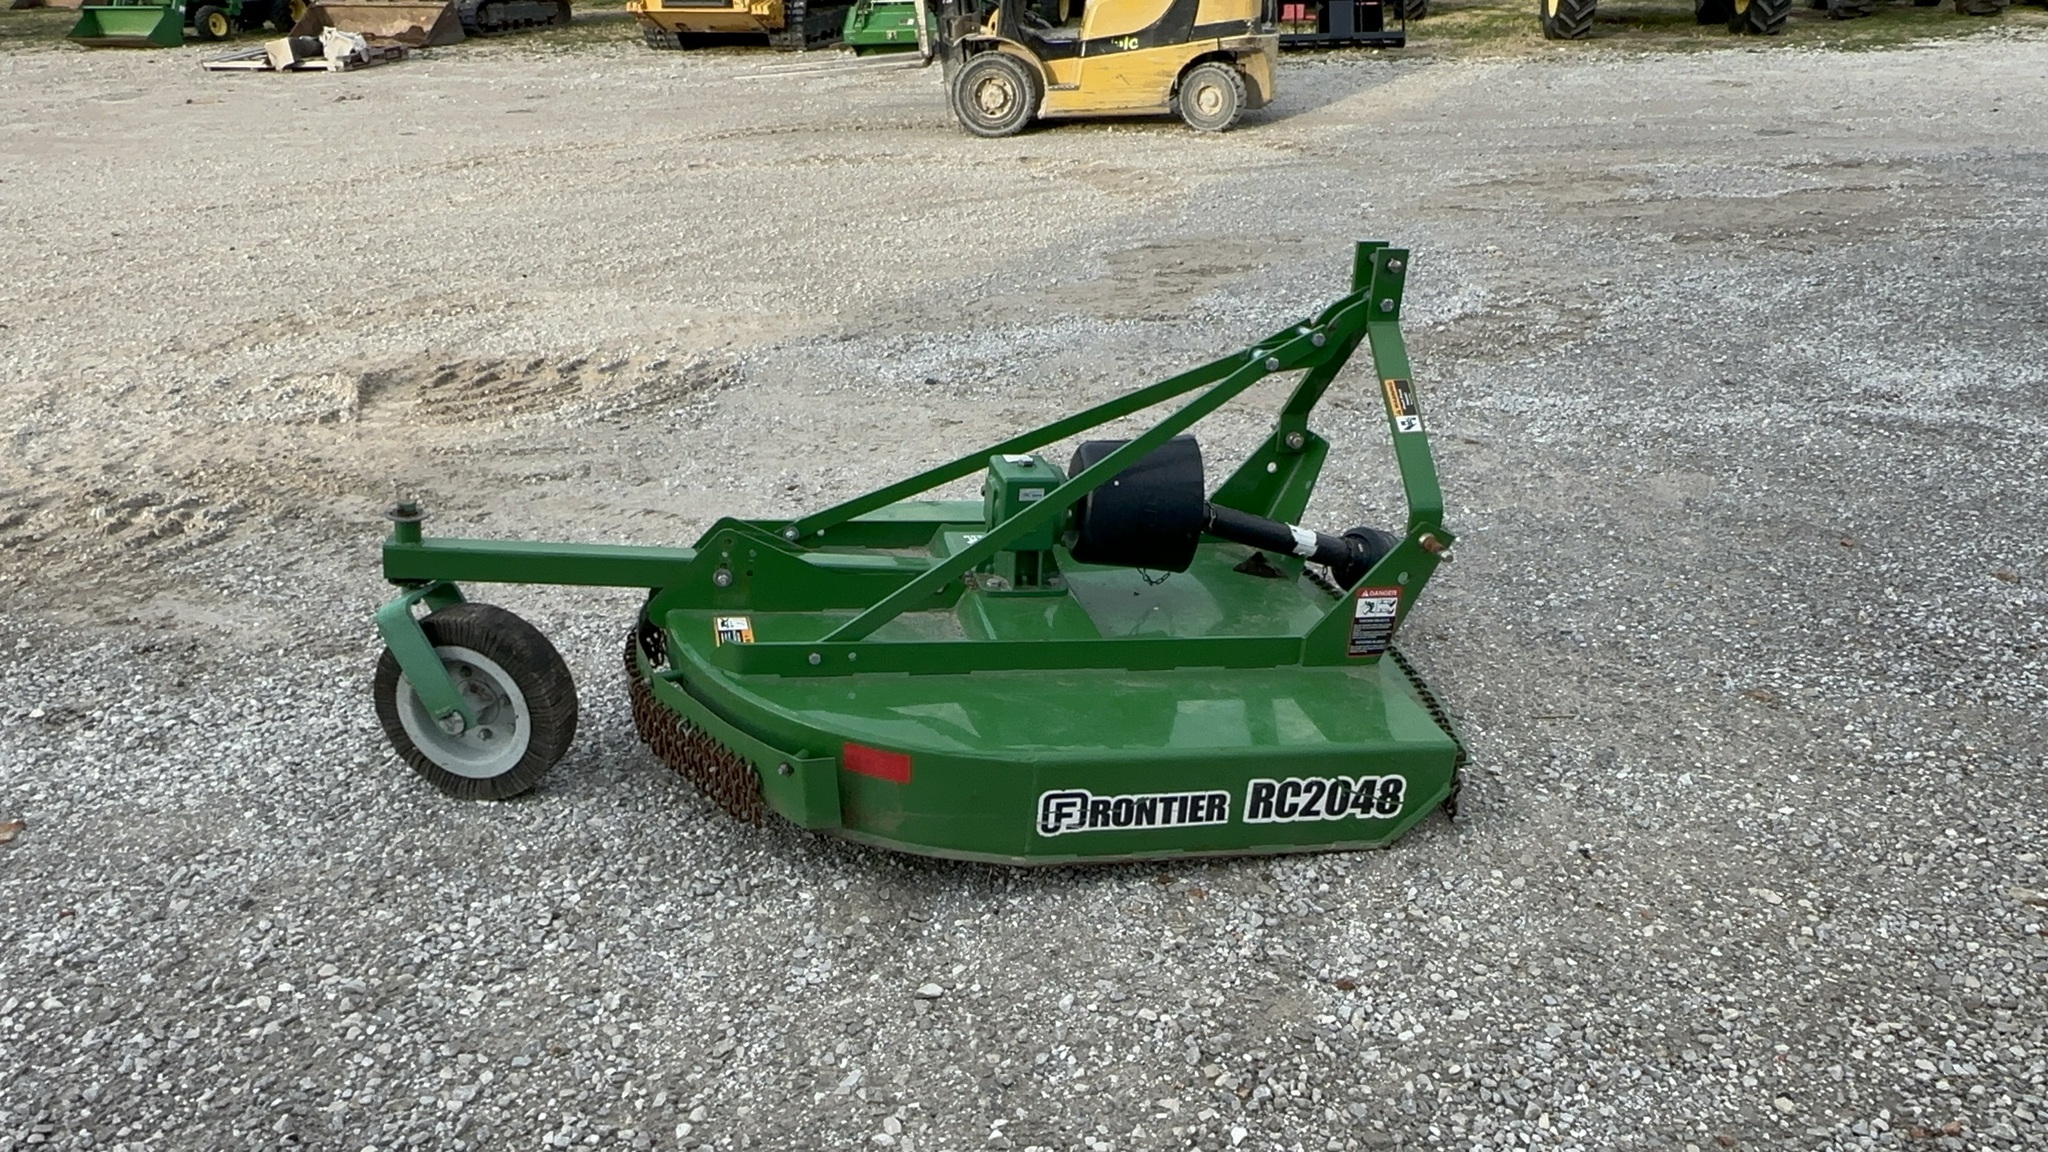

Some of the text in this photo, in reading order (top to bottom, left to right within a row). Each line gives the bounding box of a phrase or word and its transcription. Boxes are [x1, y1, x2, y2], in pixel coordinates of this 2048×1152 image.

[1369, 589, 1397, 597] DANGER
[1039, 777, 1404, 834] FRONTIER RC2048
